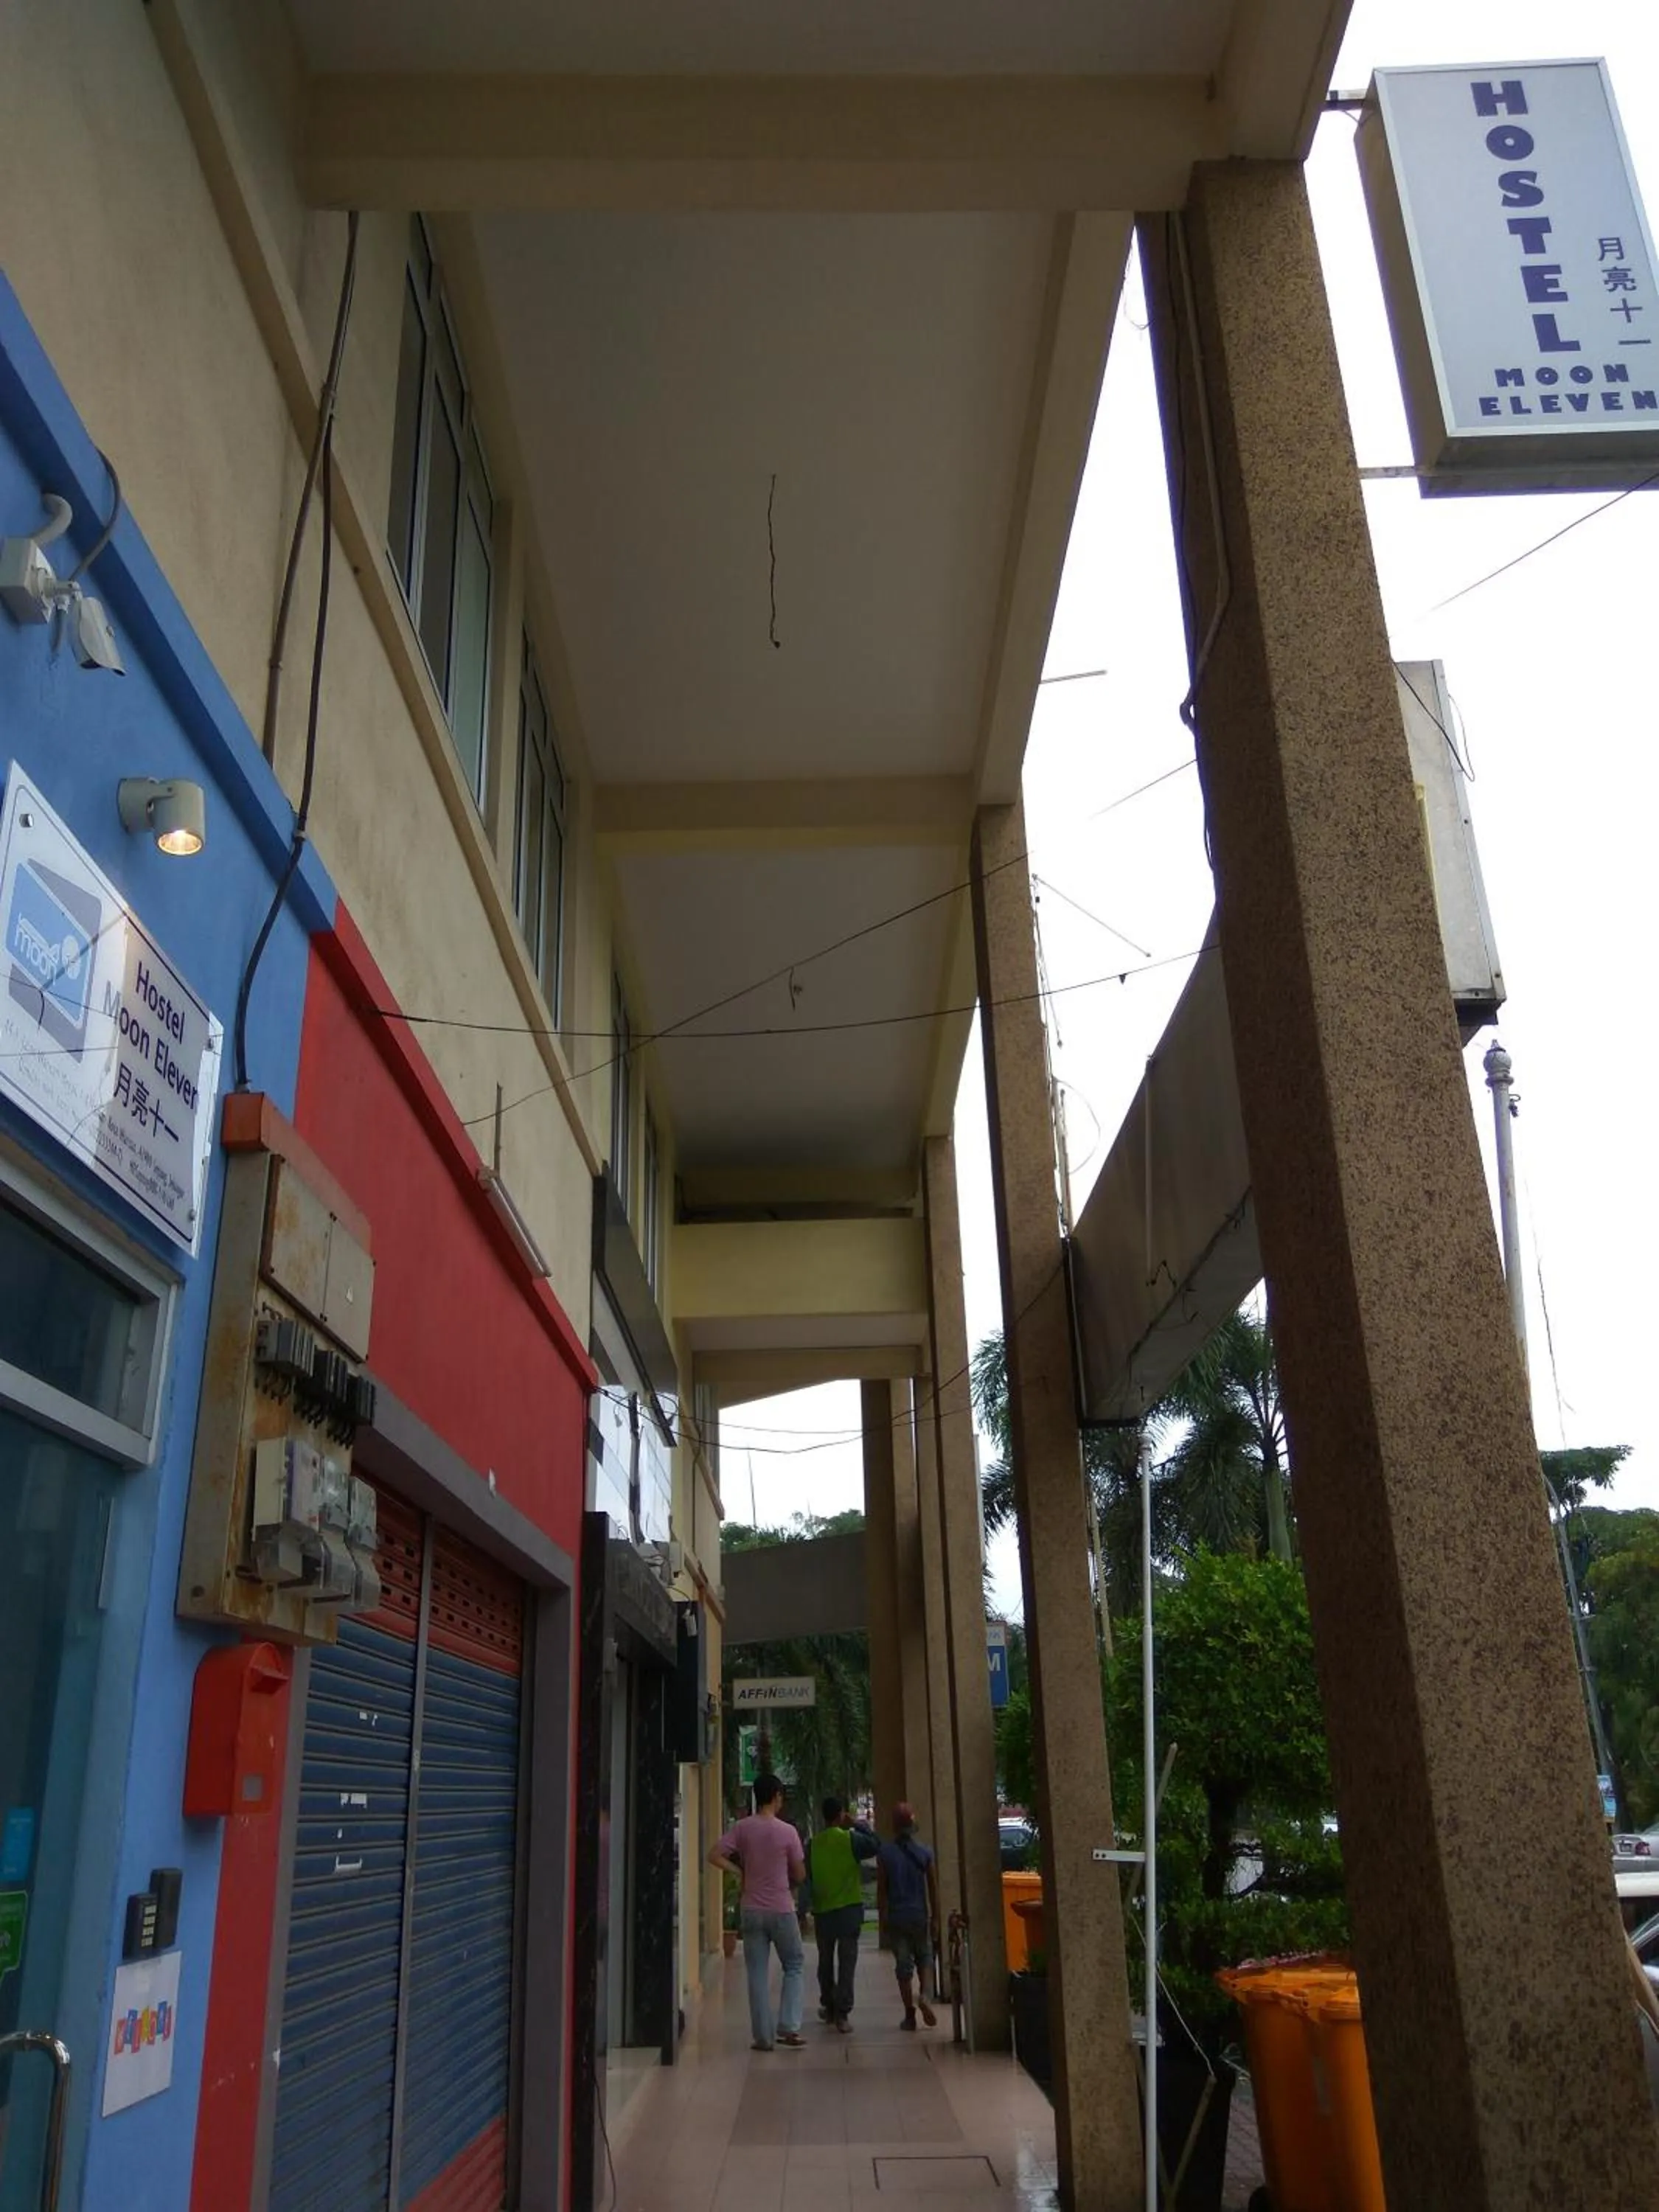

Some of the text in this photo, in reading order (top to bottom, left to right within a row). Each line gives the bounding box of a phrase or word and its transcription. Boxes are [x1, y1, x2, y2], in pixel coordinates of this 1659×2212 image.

[1470, 80, 1581, 352] HOSTEL
[1598, 237, 1651, 345] 月亮十一
[1478, 390, 1658, 416] ELEVEN
[1495, 364, 1629, 387] MOON
[103, 980, 150, 1060] Moon
[136, 961, 185, 1044] Hostel
[114, 1062, 179, 1142] 月亮十一
